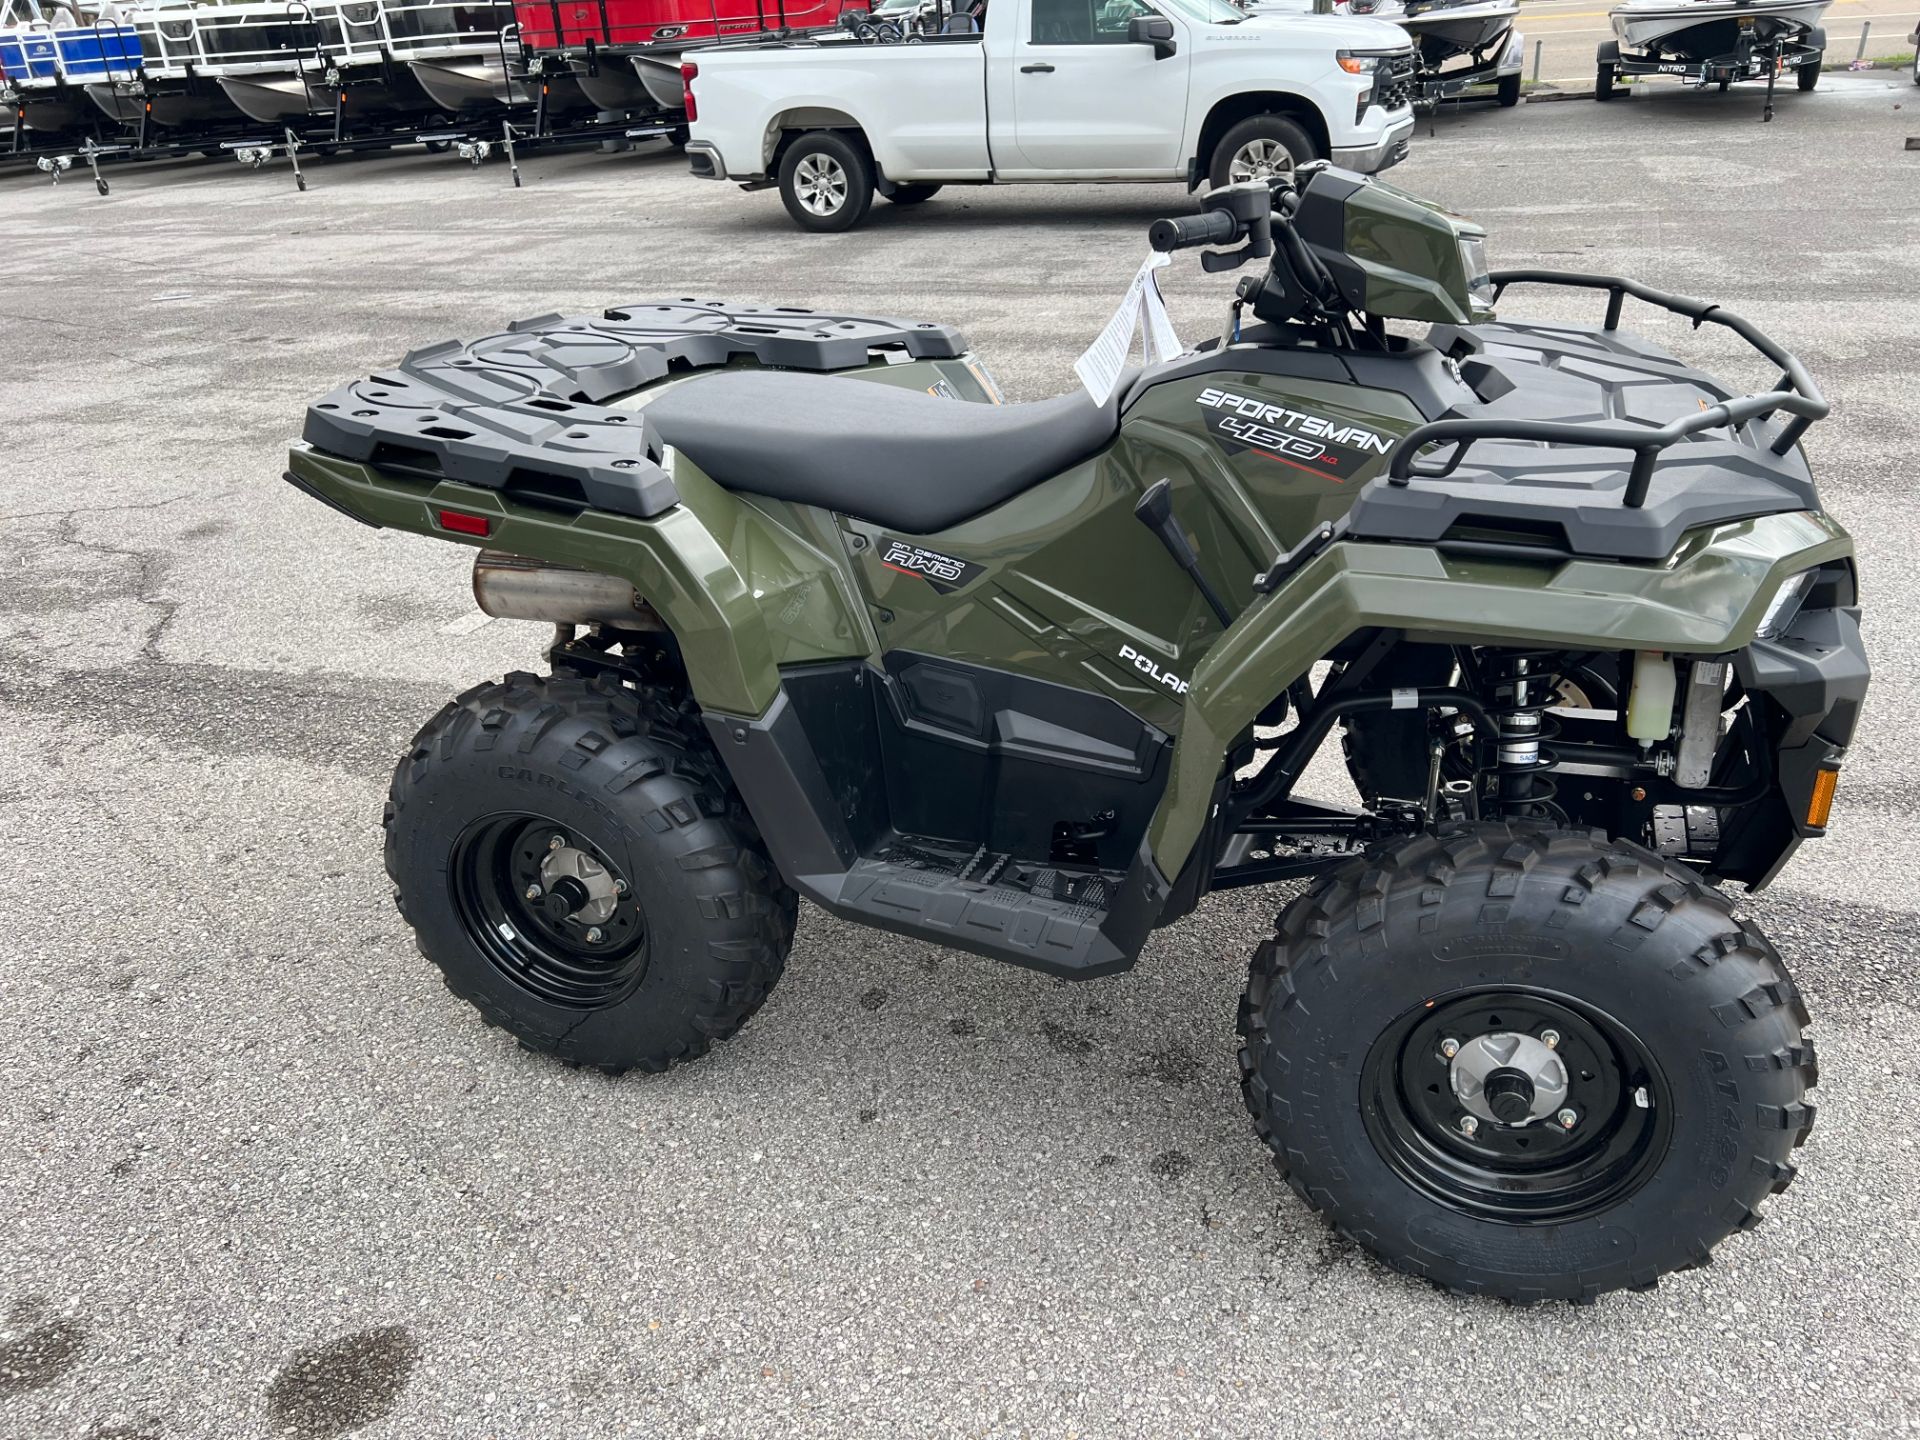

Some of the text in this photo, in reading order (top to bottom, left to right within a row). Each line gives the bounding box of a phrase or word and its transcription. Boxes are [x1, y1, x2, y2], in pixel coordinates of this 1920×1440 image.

[1195, 387, 1395, 455] SPORTSMAN
[1218, 416, 1326, 461] 450
[883, 548, 961, 581] AWD
[892, 541, 966, 568] ON DEMAND
